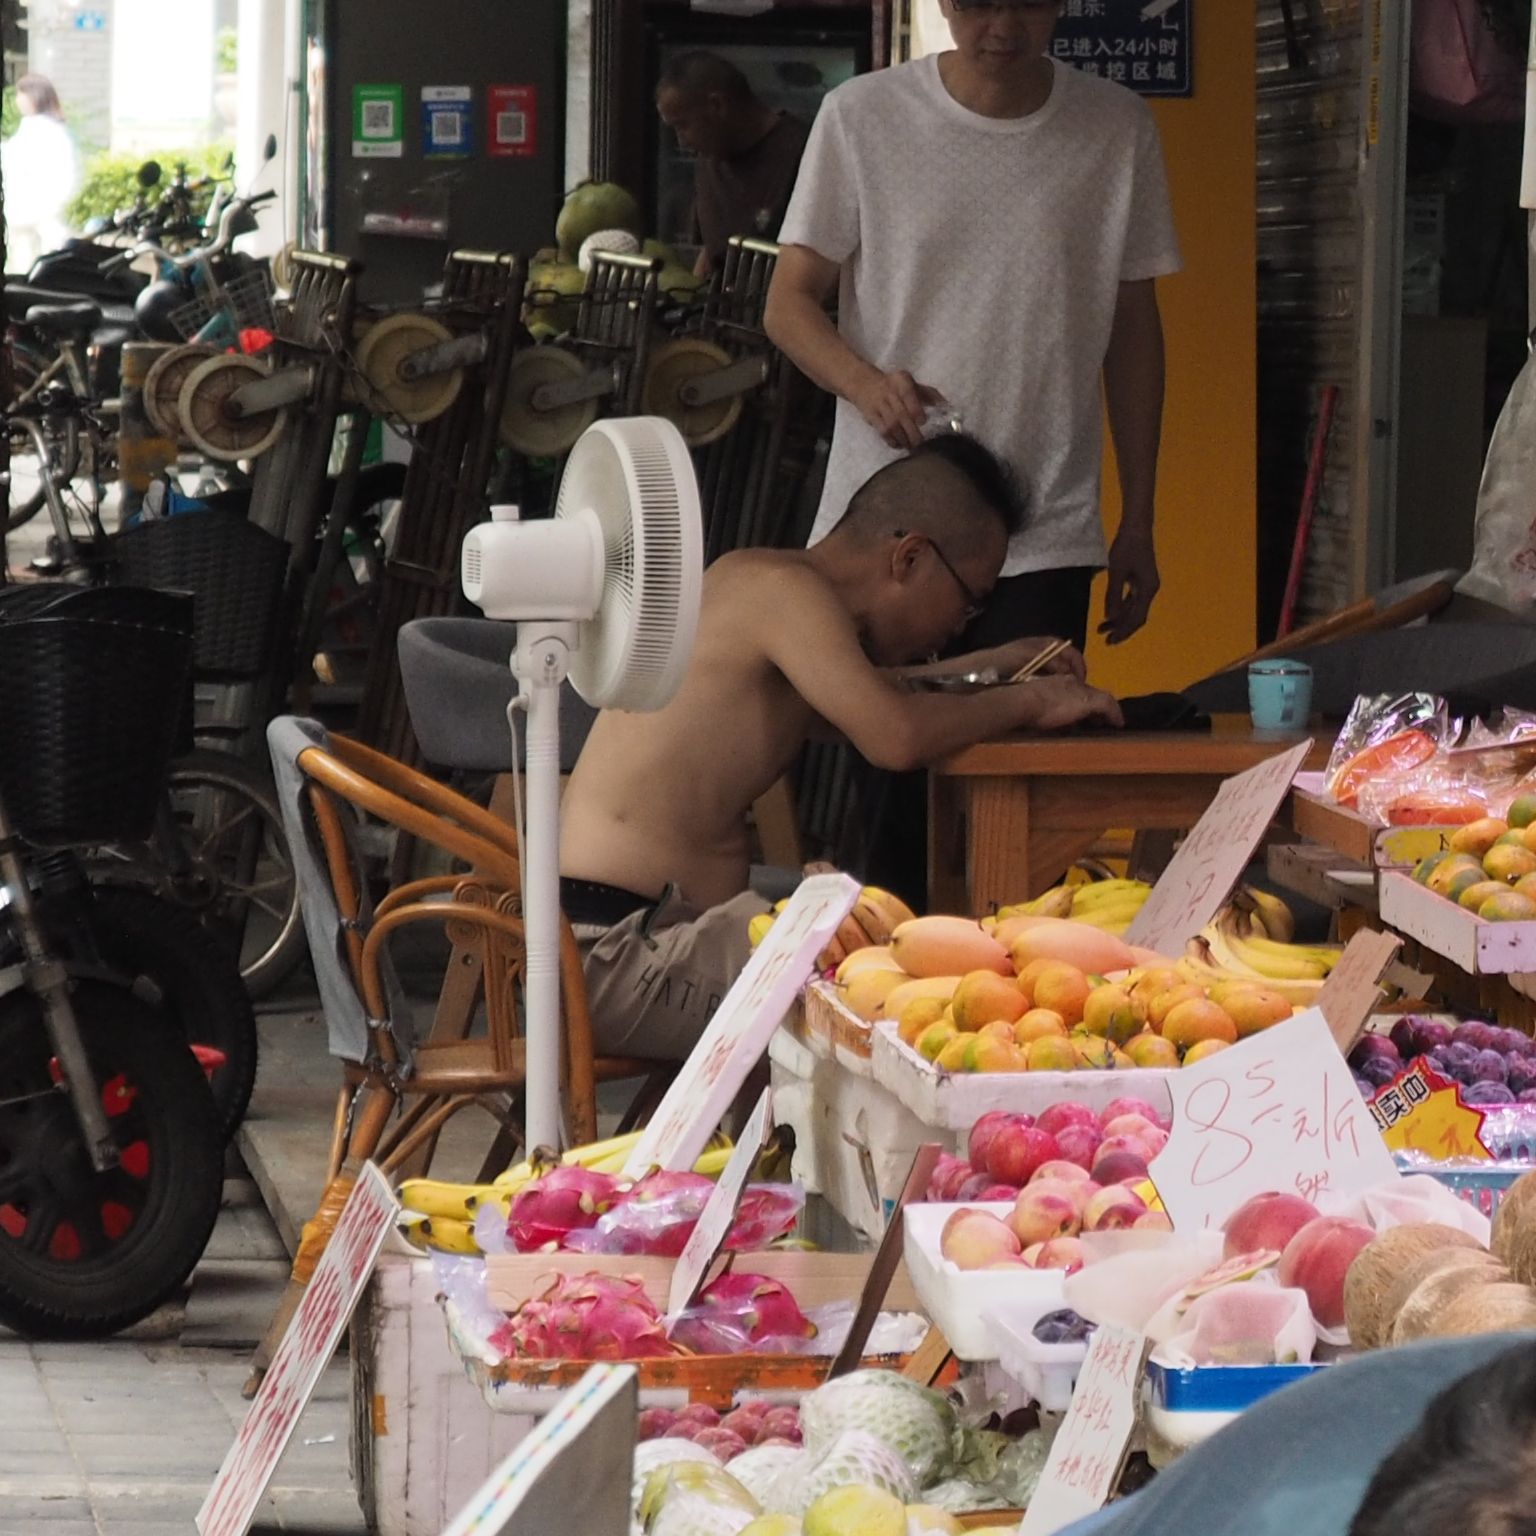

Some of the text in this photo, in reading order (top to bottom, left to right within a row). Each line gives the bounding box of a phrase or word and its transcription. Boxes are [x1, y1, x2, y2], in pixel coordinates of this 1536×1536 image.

[1046, 37, 1178, 58] 已进入24小时
[1070, 60, 1177, 81] 监控区域
